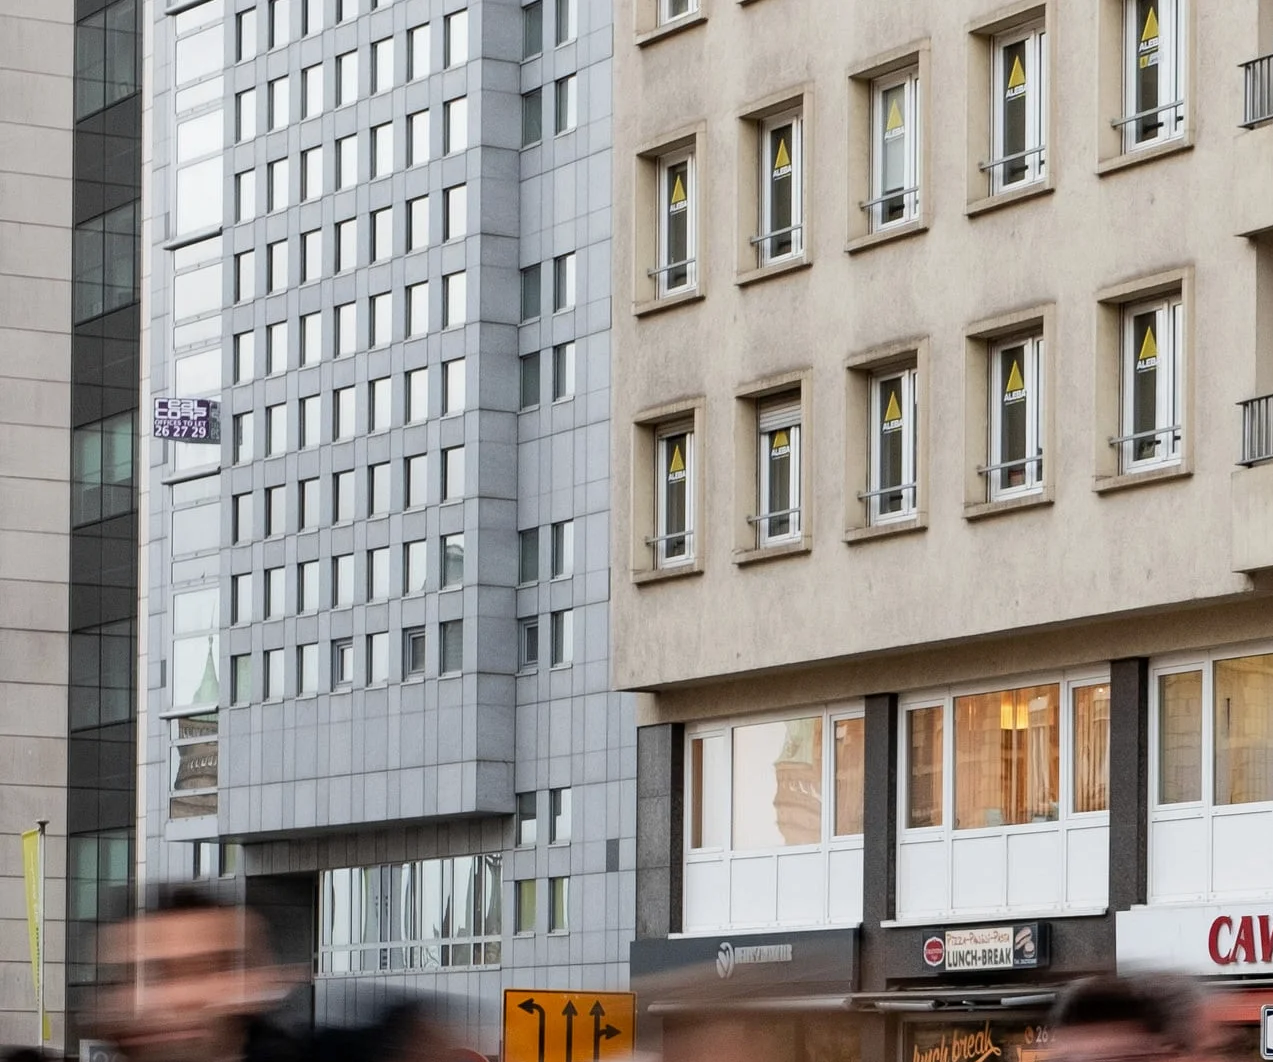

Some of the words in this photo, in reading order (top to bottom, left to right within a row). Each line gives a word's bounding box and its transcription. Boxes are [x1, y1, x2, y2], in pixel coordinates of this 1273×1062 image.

[155, 426, 169, 437] 26
[173, 426, 188, 437] 27
[191, 427, 206, 438] 29
[947, 947, 1012, 968] LUNCH-BREAK
